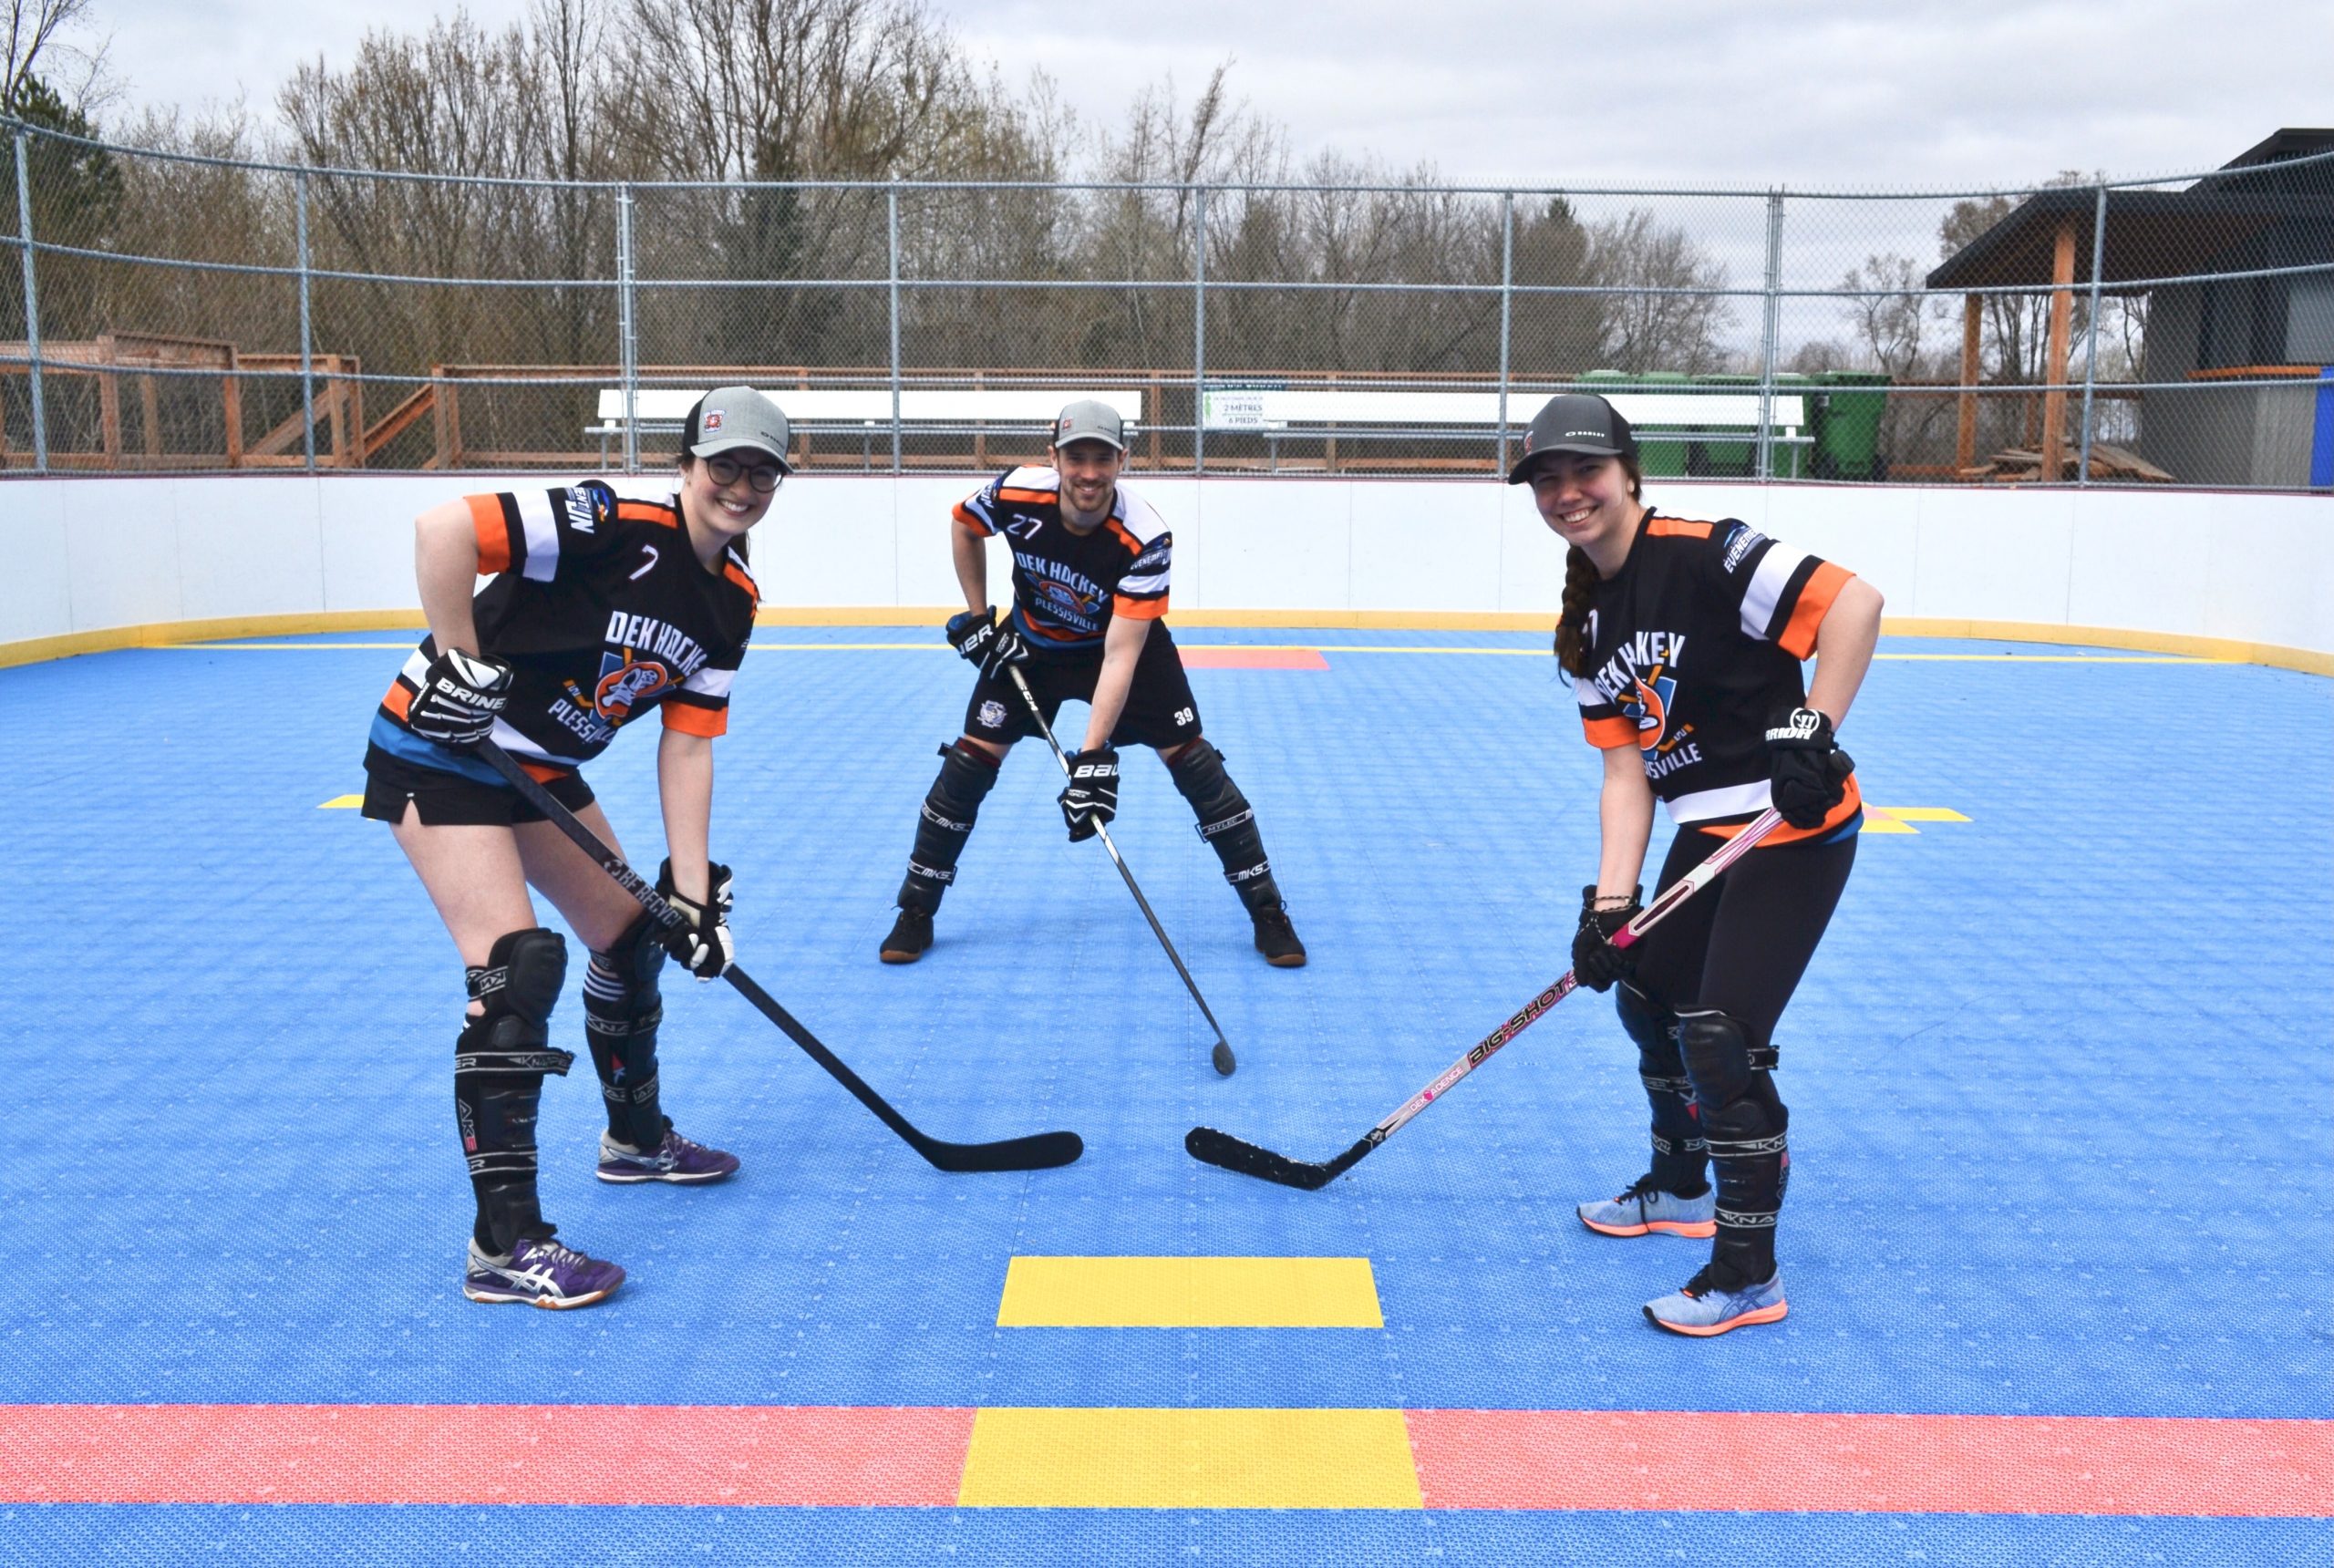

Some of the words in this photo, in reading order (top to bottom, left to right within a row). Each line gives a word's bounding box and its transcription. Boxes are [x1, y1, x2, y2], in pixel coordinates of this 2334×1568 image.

[1007, 513, 1043, 540] 27
[629, 544, 658, 580] 7
[1016, 552, 1047, 574] DEK
[1049, 562, 1110, 603] HOCKEY
[1035, 597, 1099, 631] PLESSISVILLE
[605, 611, 658, 650] DEK
[653, 623, 707, 676] HOCKE
[436, 677, 507, 709] BRINE
[1174, 707, 1194, 727] 39
